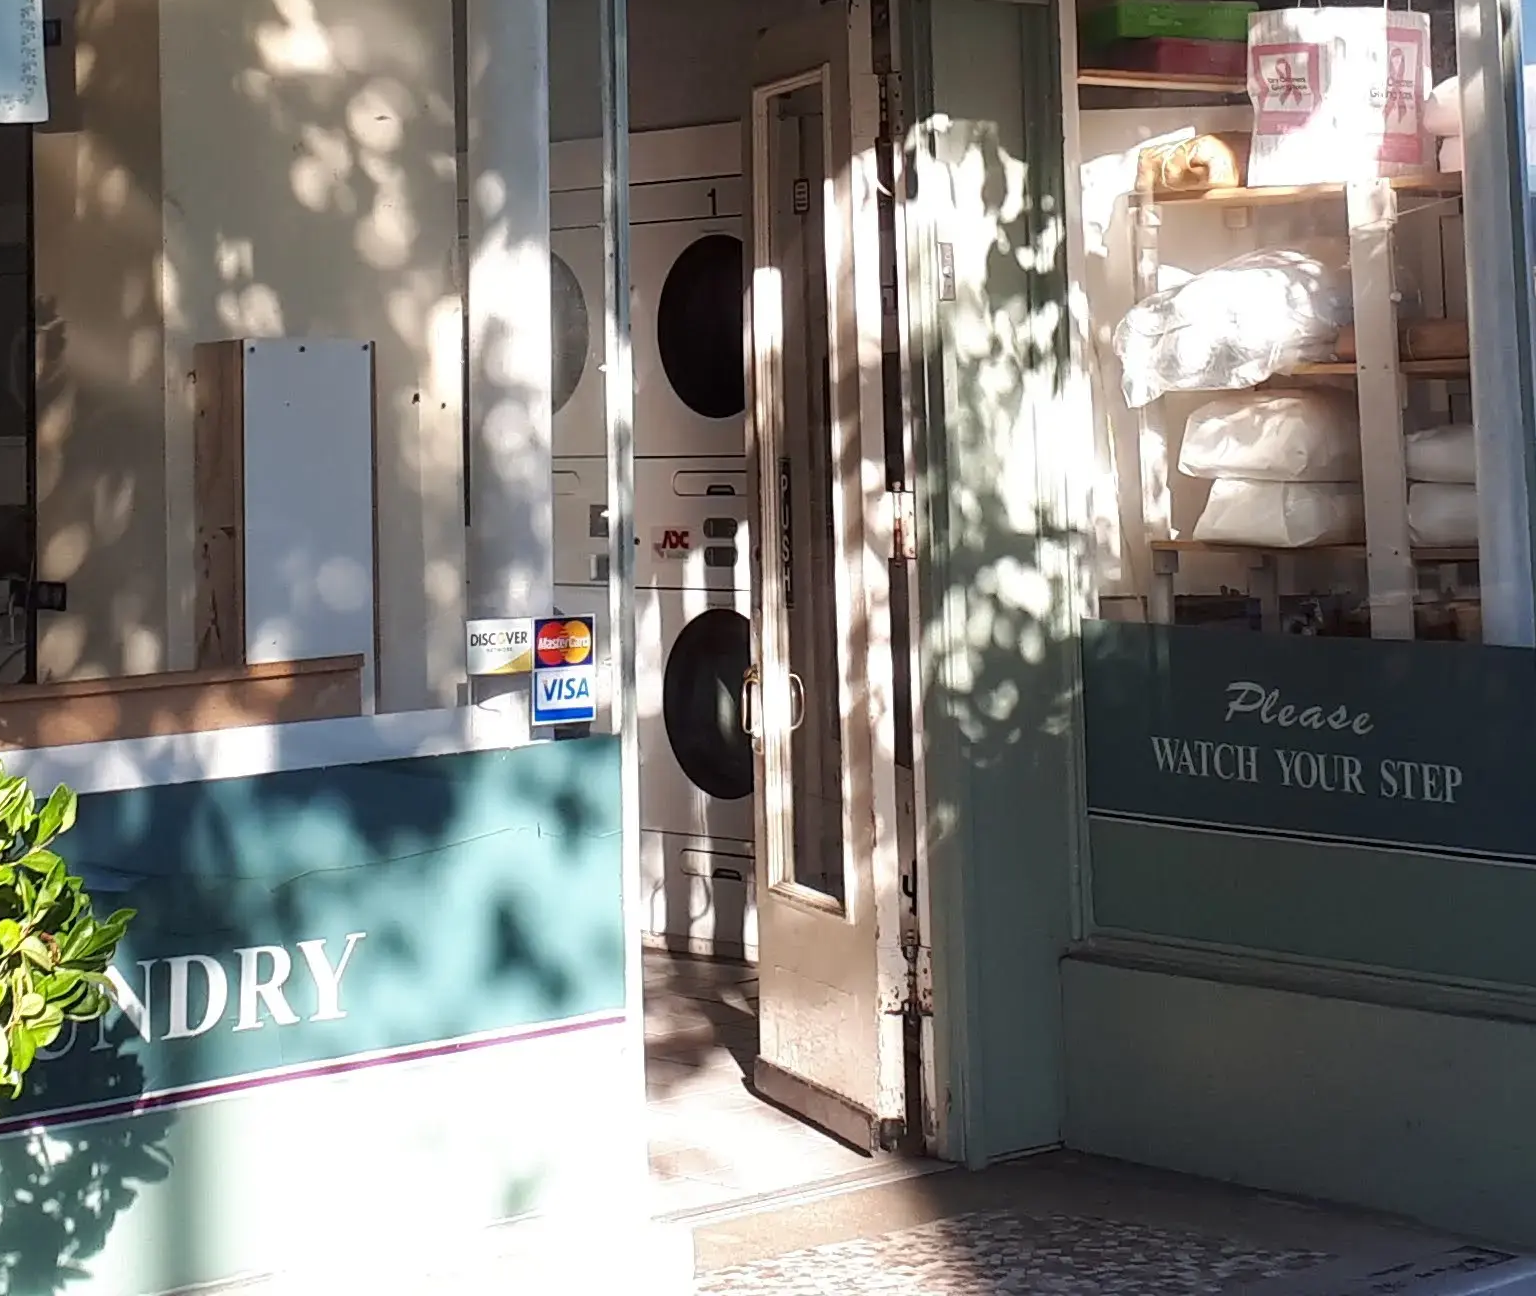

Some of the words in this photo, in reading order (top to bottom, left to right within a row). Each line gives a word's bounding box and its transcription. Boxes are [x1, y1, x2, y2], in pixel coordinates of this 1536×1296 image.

[706, 187, 717, 215] 1
[780, 473, 791, 592] PUSH
[470, 630, 528, 647] DISCOVER
[543, 677, 590, 702] VISA
[1225, 680, 1374, 735] Please
[1150, 735, 1261, 784] WATCH
[1275, 748, 1366, 795] YOUR
[1380, 758, 1463, 803] STEP
[38, 931, 367, 1062] NDRY
